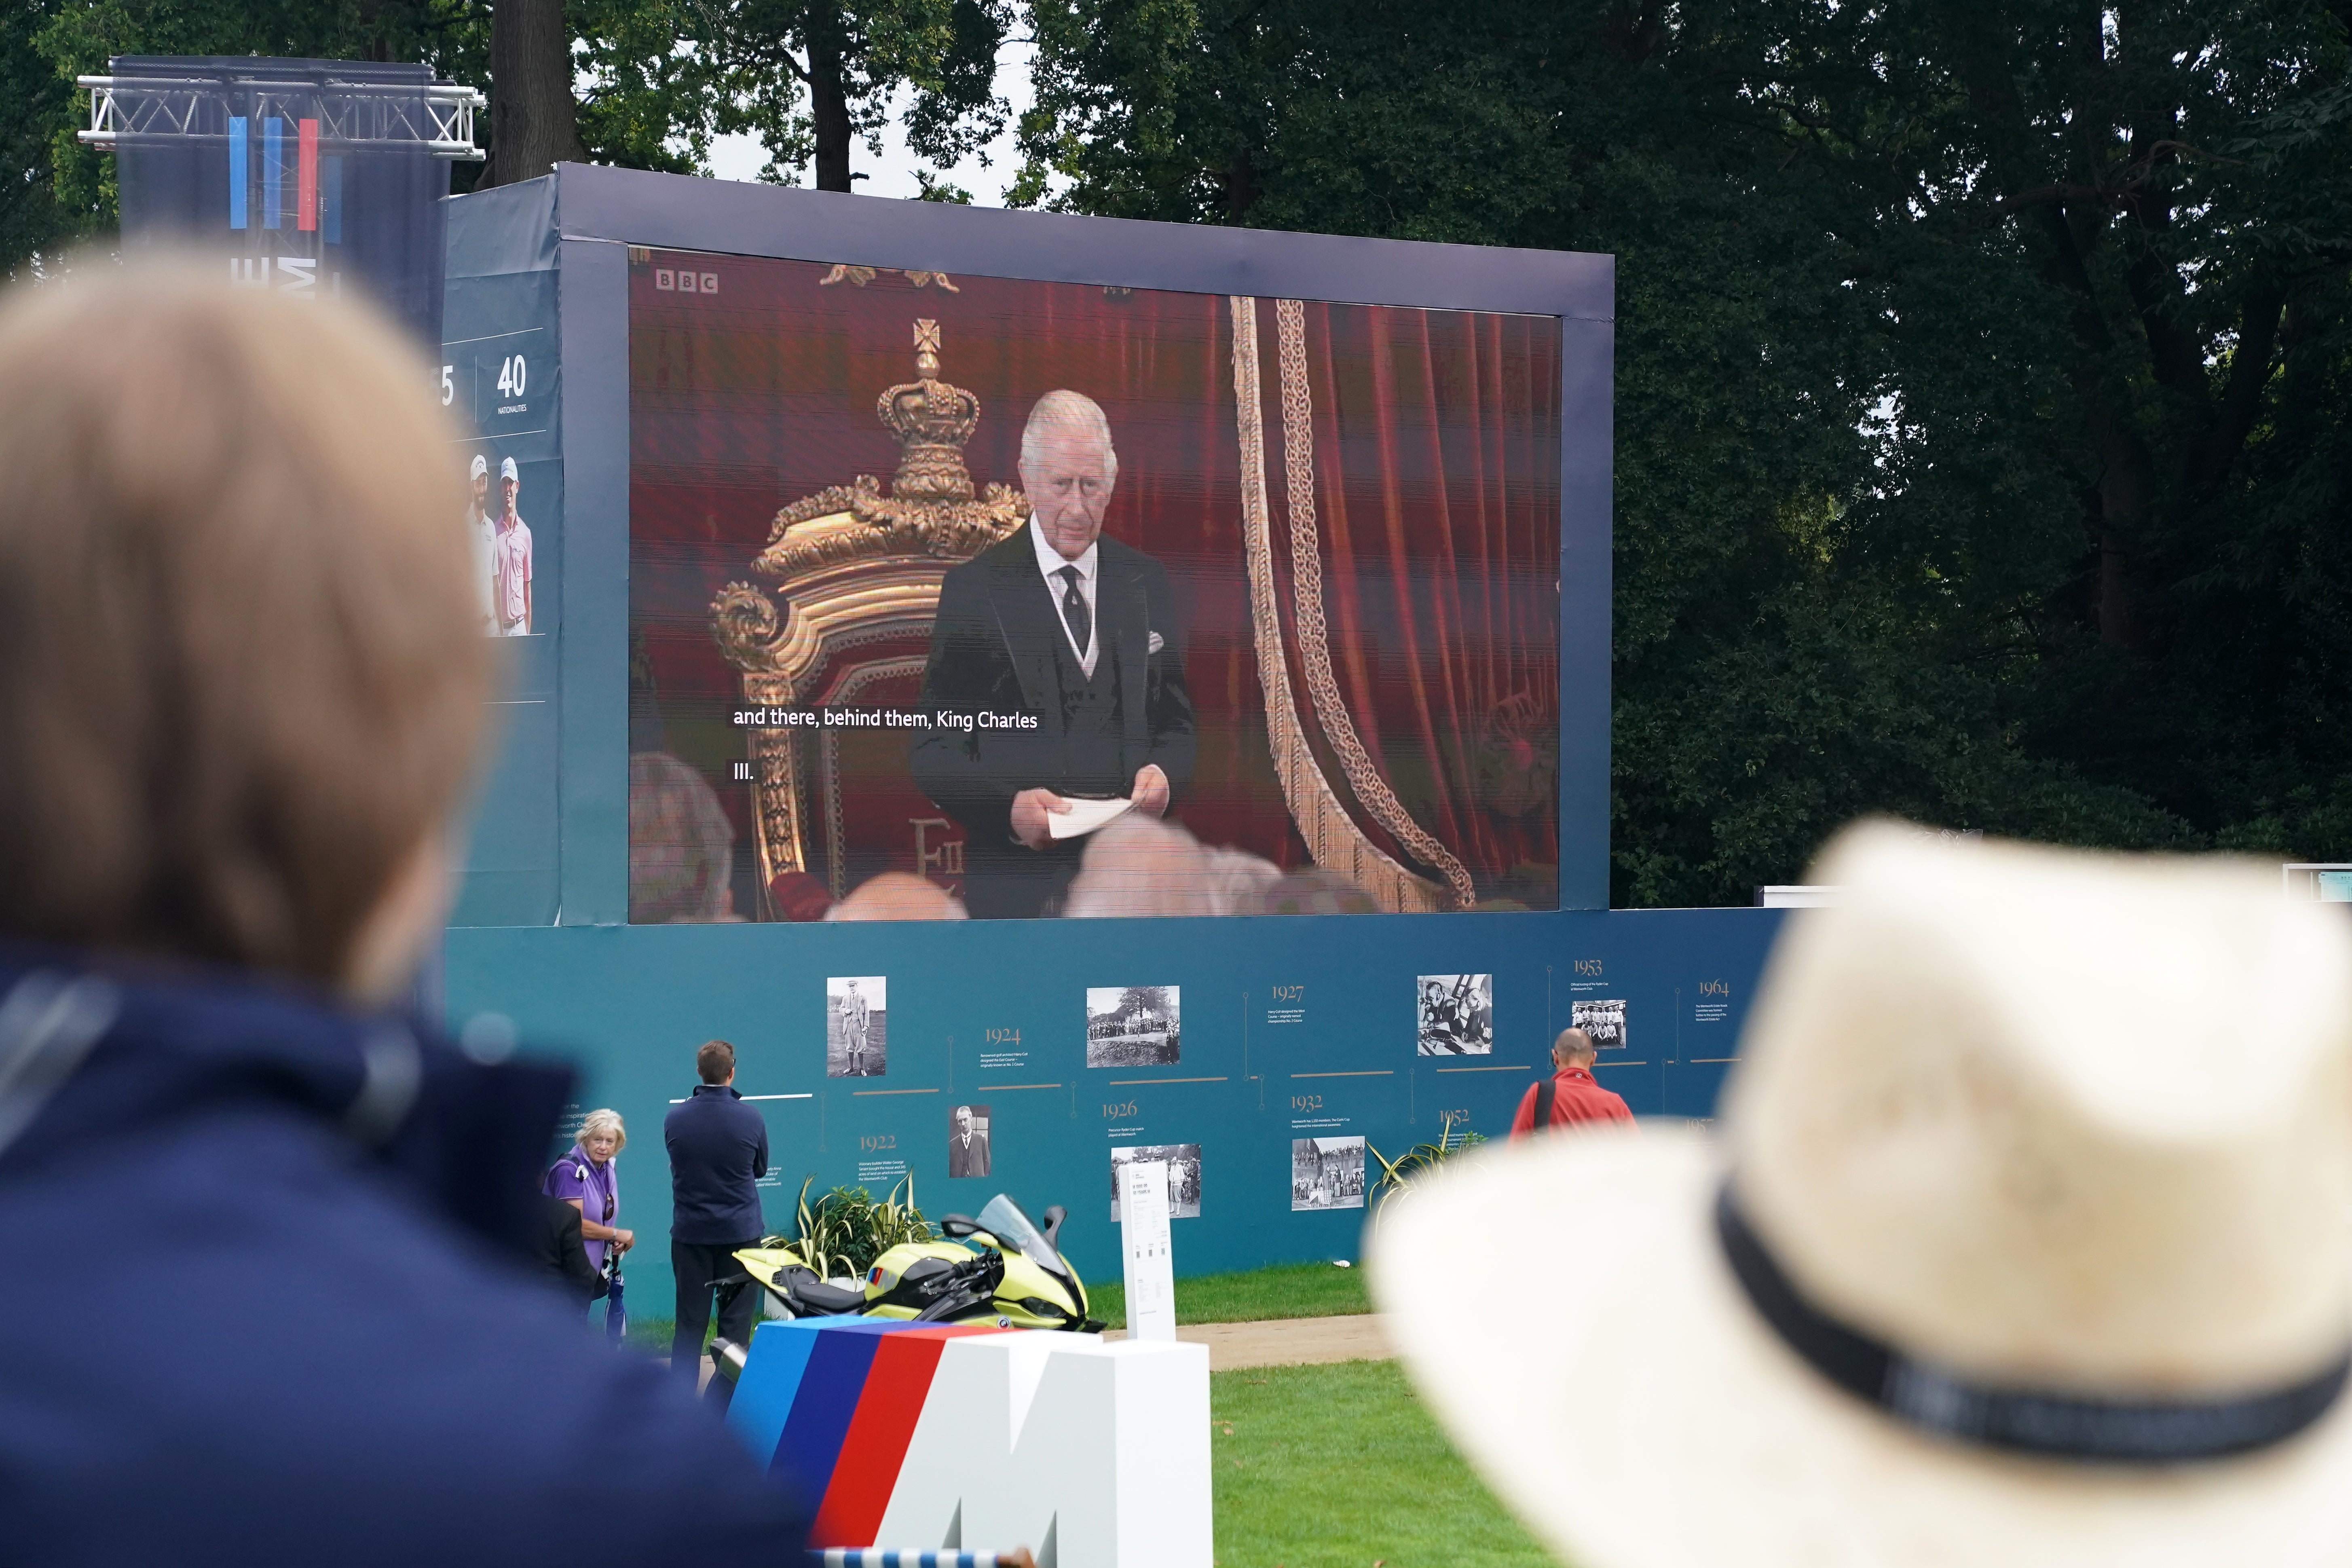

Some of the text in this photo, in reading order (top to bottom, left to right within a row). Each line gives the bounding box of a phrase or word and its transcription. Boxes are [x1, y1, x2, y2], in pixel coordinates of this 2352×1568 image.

[658, 271, 717, 292] BBC
[497, 354, 526, 398] 40
[498, 404, 526, 414] NATIONALITIES
[734, 708, 1038, 732] and there, behind them, King Charles
[734, 763, 754, 780] III.
[1574, 959, 1602, 976] 1953
[1273, 986, 1304, 1002] 1927
[1700, 978, 1729, 997] 1964
[986, 1028, 1021, 1046] 1924
[1103, 1099, 1137, 1121] 1926
[1291, 1095, 1323, 1113] 1932
[1440, 1109, 1469, 1126] 1952
[860, 1135, 897, 1154] 1922
